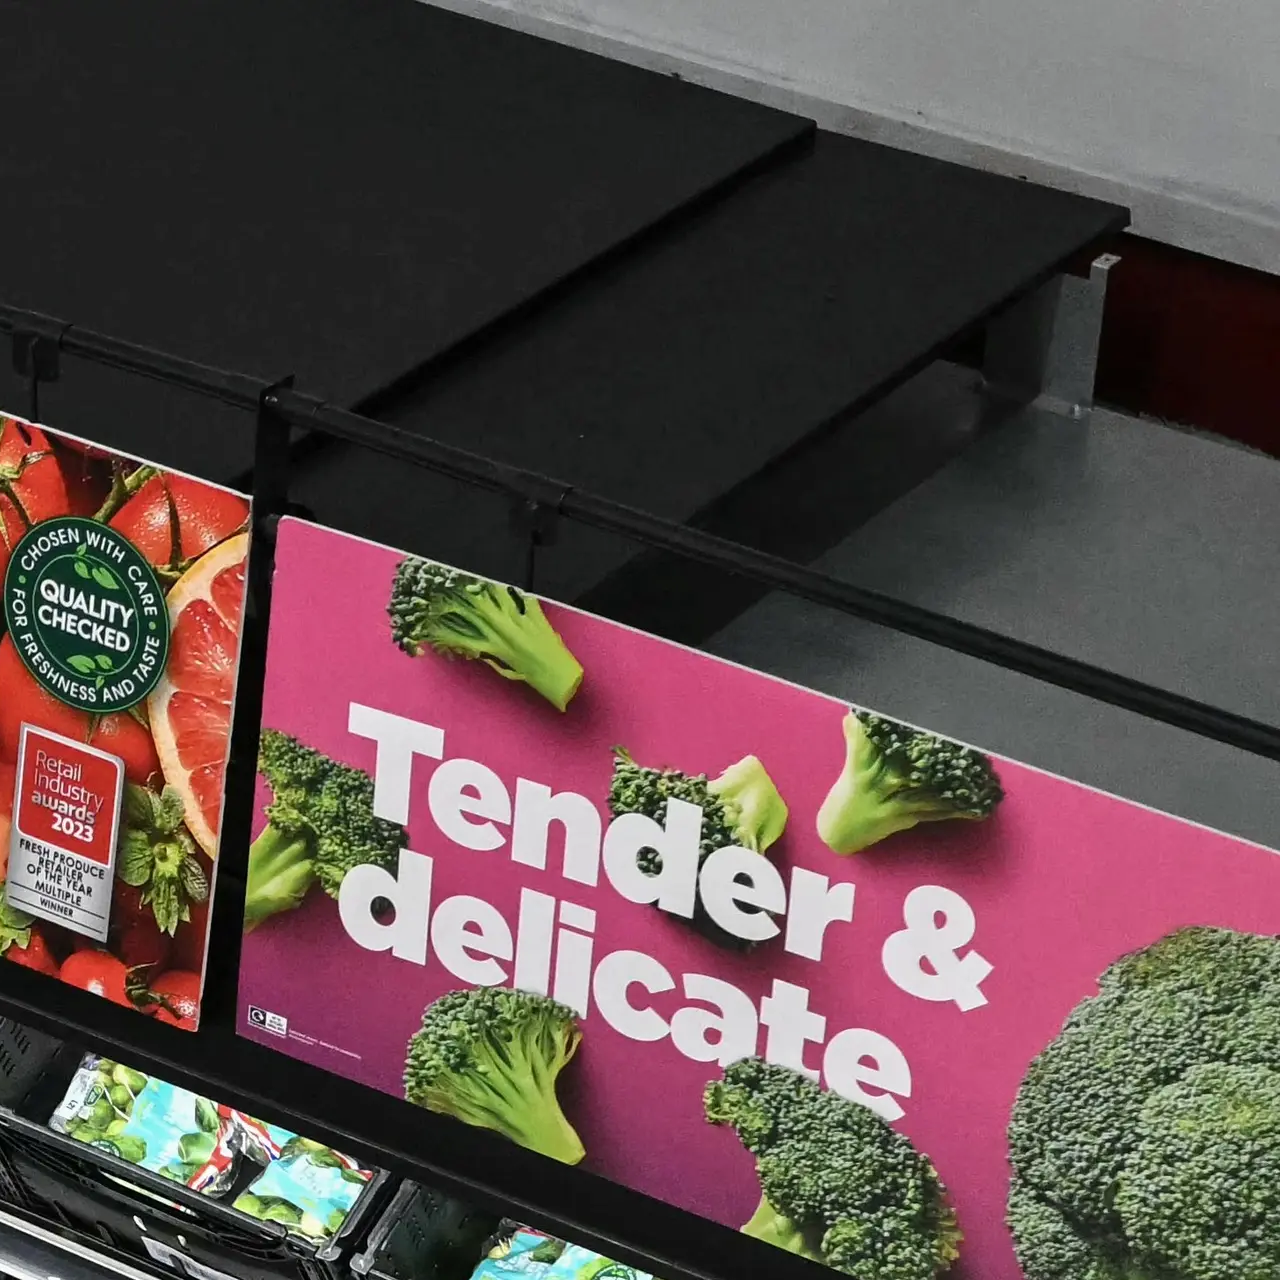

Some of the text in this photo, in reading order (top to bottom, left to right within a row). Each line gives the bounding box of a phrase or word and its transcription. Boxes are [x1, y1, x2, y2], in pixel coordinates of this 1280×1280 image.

[21, 528, 158, 617] CHOSEN WITH CARE
[40, 578, 135, 628] QUALITY
[12, 588, 160, 703] FOR FRESHNESS AND TASTE
[38, 605, 131, 652] CHECKED
[35, 749, 82, 778] Retail
[31, 790, 95, 824] awards
[34, 768, 104, 813] Industry
[51, 813, 94, 843] 2023
[19, 838, 105, 880] FRESH PRODUCE
[38, 857, 83, 882] RETAILER
[346, 701, 994, 1012] Tender &
[27, 864, 93, 898] OF THE YEAR
[35, 881, 82, 907] MULTIPLE
[40, 898, 74, 918] WINNER
[337, 848, 912, 1121] delicate
